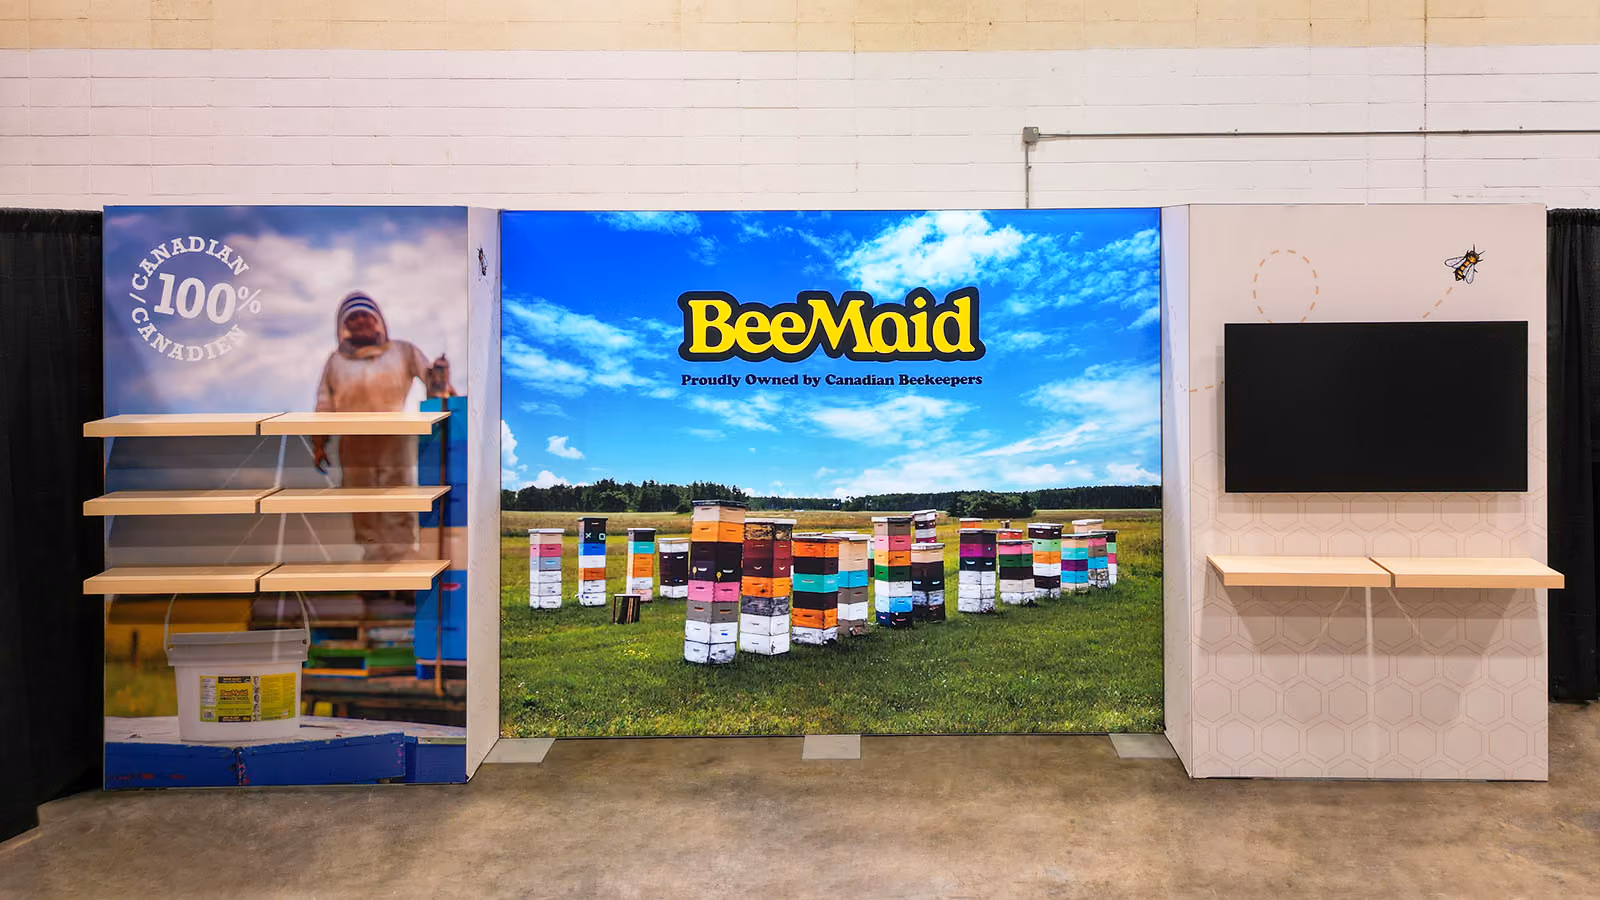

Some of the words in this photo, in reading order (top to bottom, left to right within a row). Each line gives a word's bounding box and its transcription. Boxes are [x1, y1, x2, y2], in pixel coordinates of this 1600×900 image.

[131, 236, 250, 290] CANADIAN
[153, 272, 262, 324] 100%
[686, 294, 978, 356] BeeMaid
[131, 307, 247, 361] CANADIEN
[681, 374, 741, 387] Proudly
[745, 374, 798, 385] Owned
[803, 374, 821, 387] by
[825, 374, 894, 386] Canadian
[899, 374, 983, 387] Beekeepers
